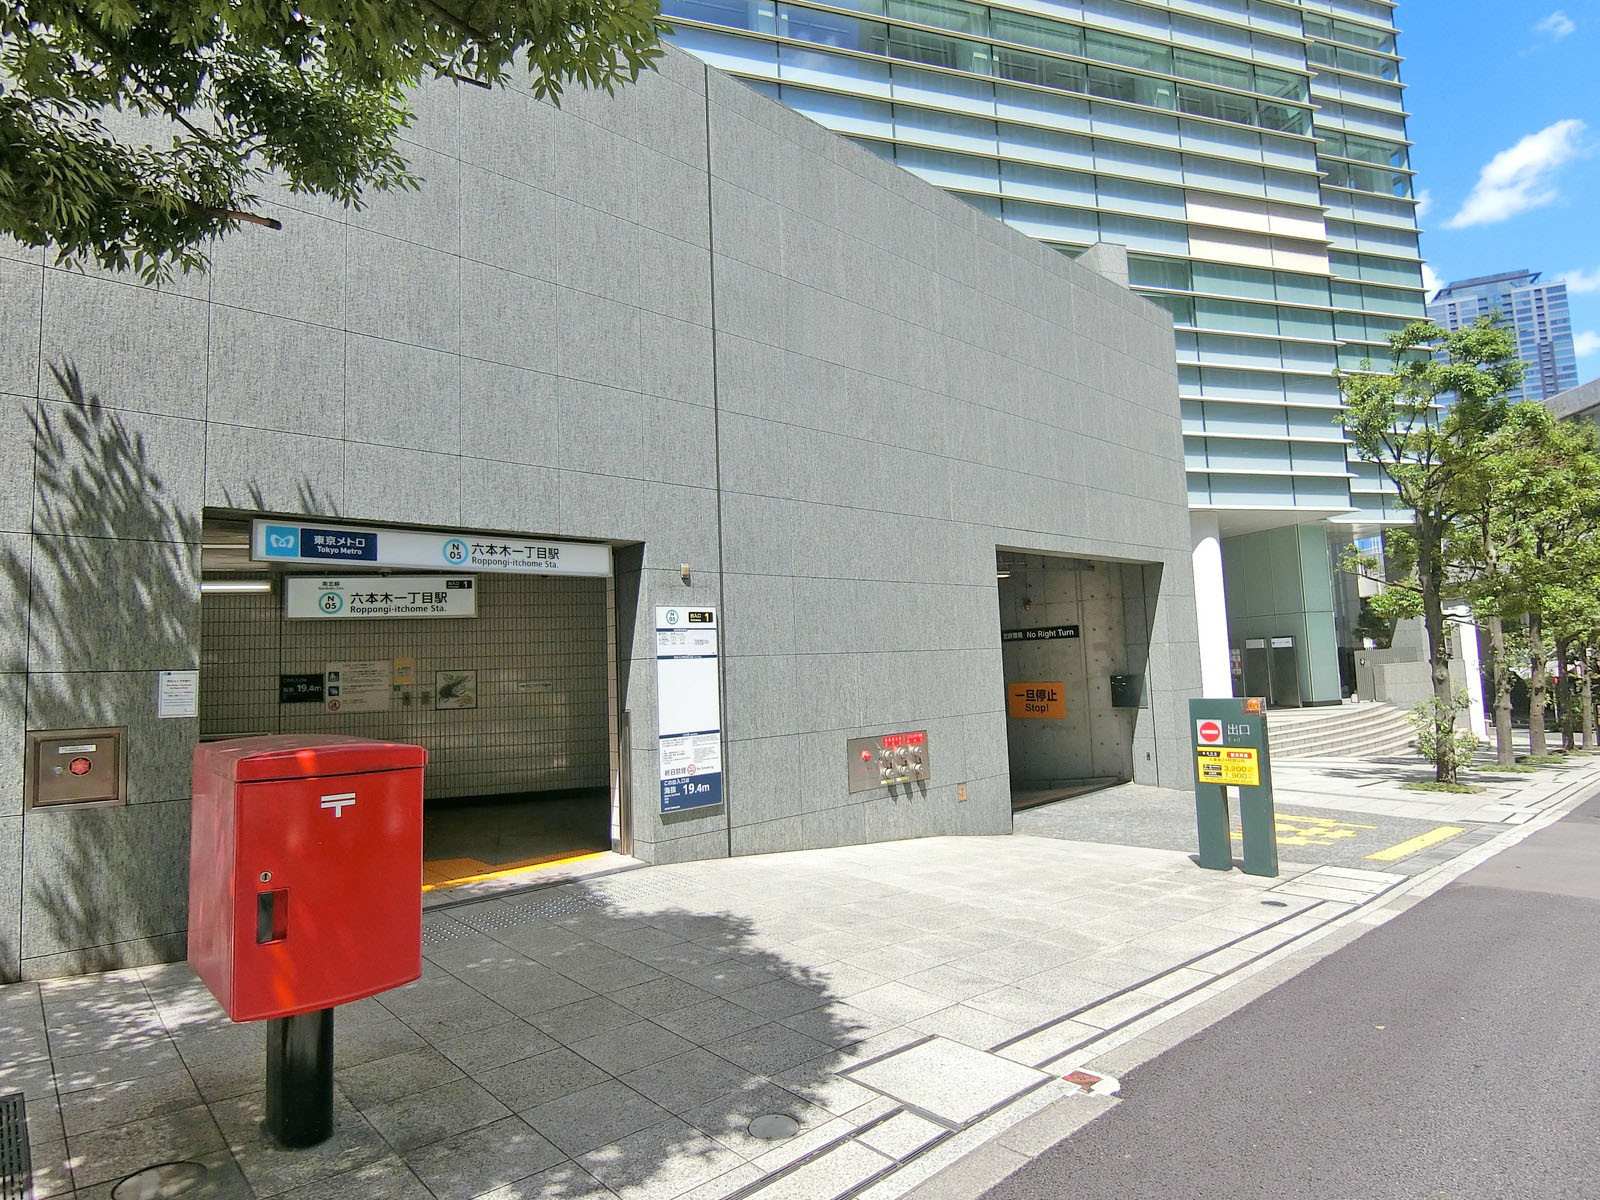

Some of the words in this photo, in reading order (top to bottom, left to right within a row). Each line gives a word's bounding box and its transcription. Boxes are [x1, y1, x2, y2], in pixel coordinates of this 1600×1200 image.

[313, 535, 366, 548] 東京メトロ
[452, 543, 460, 551] N
[317, 545, 340, 555] Tokyo
[340, 547, 363, 556] Metro
[449, 551, 462, 560] 05
[471, 542, 560, 560] 六本木一丁目駅
[471, 556, 543, 568] Roppongi-itchome
[544, 560, 559, 569] Sta.
[463, 580, 468, 589] 1
[350, 592, 448, 605] 六本木一丁目駅
[324, 602, 337, 610] 05
[350, 605, 428, 615] Roppongi-itchome
[430, 604, 447, 612] Sta.
[704, 612, 709, 622] 1
[1037, 630, 1056, 639] Right
[1057, 629, 1074, 637] Turn
[297, 684, 322, 693] 19.4m
[1015, 689, 1058, 702] 一旦停止
[1025, 703, 1049, 714] Stop!
[1227, 723, 1250, 736] 出口
[682, 783, 710, 795] 19.4m
